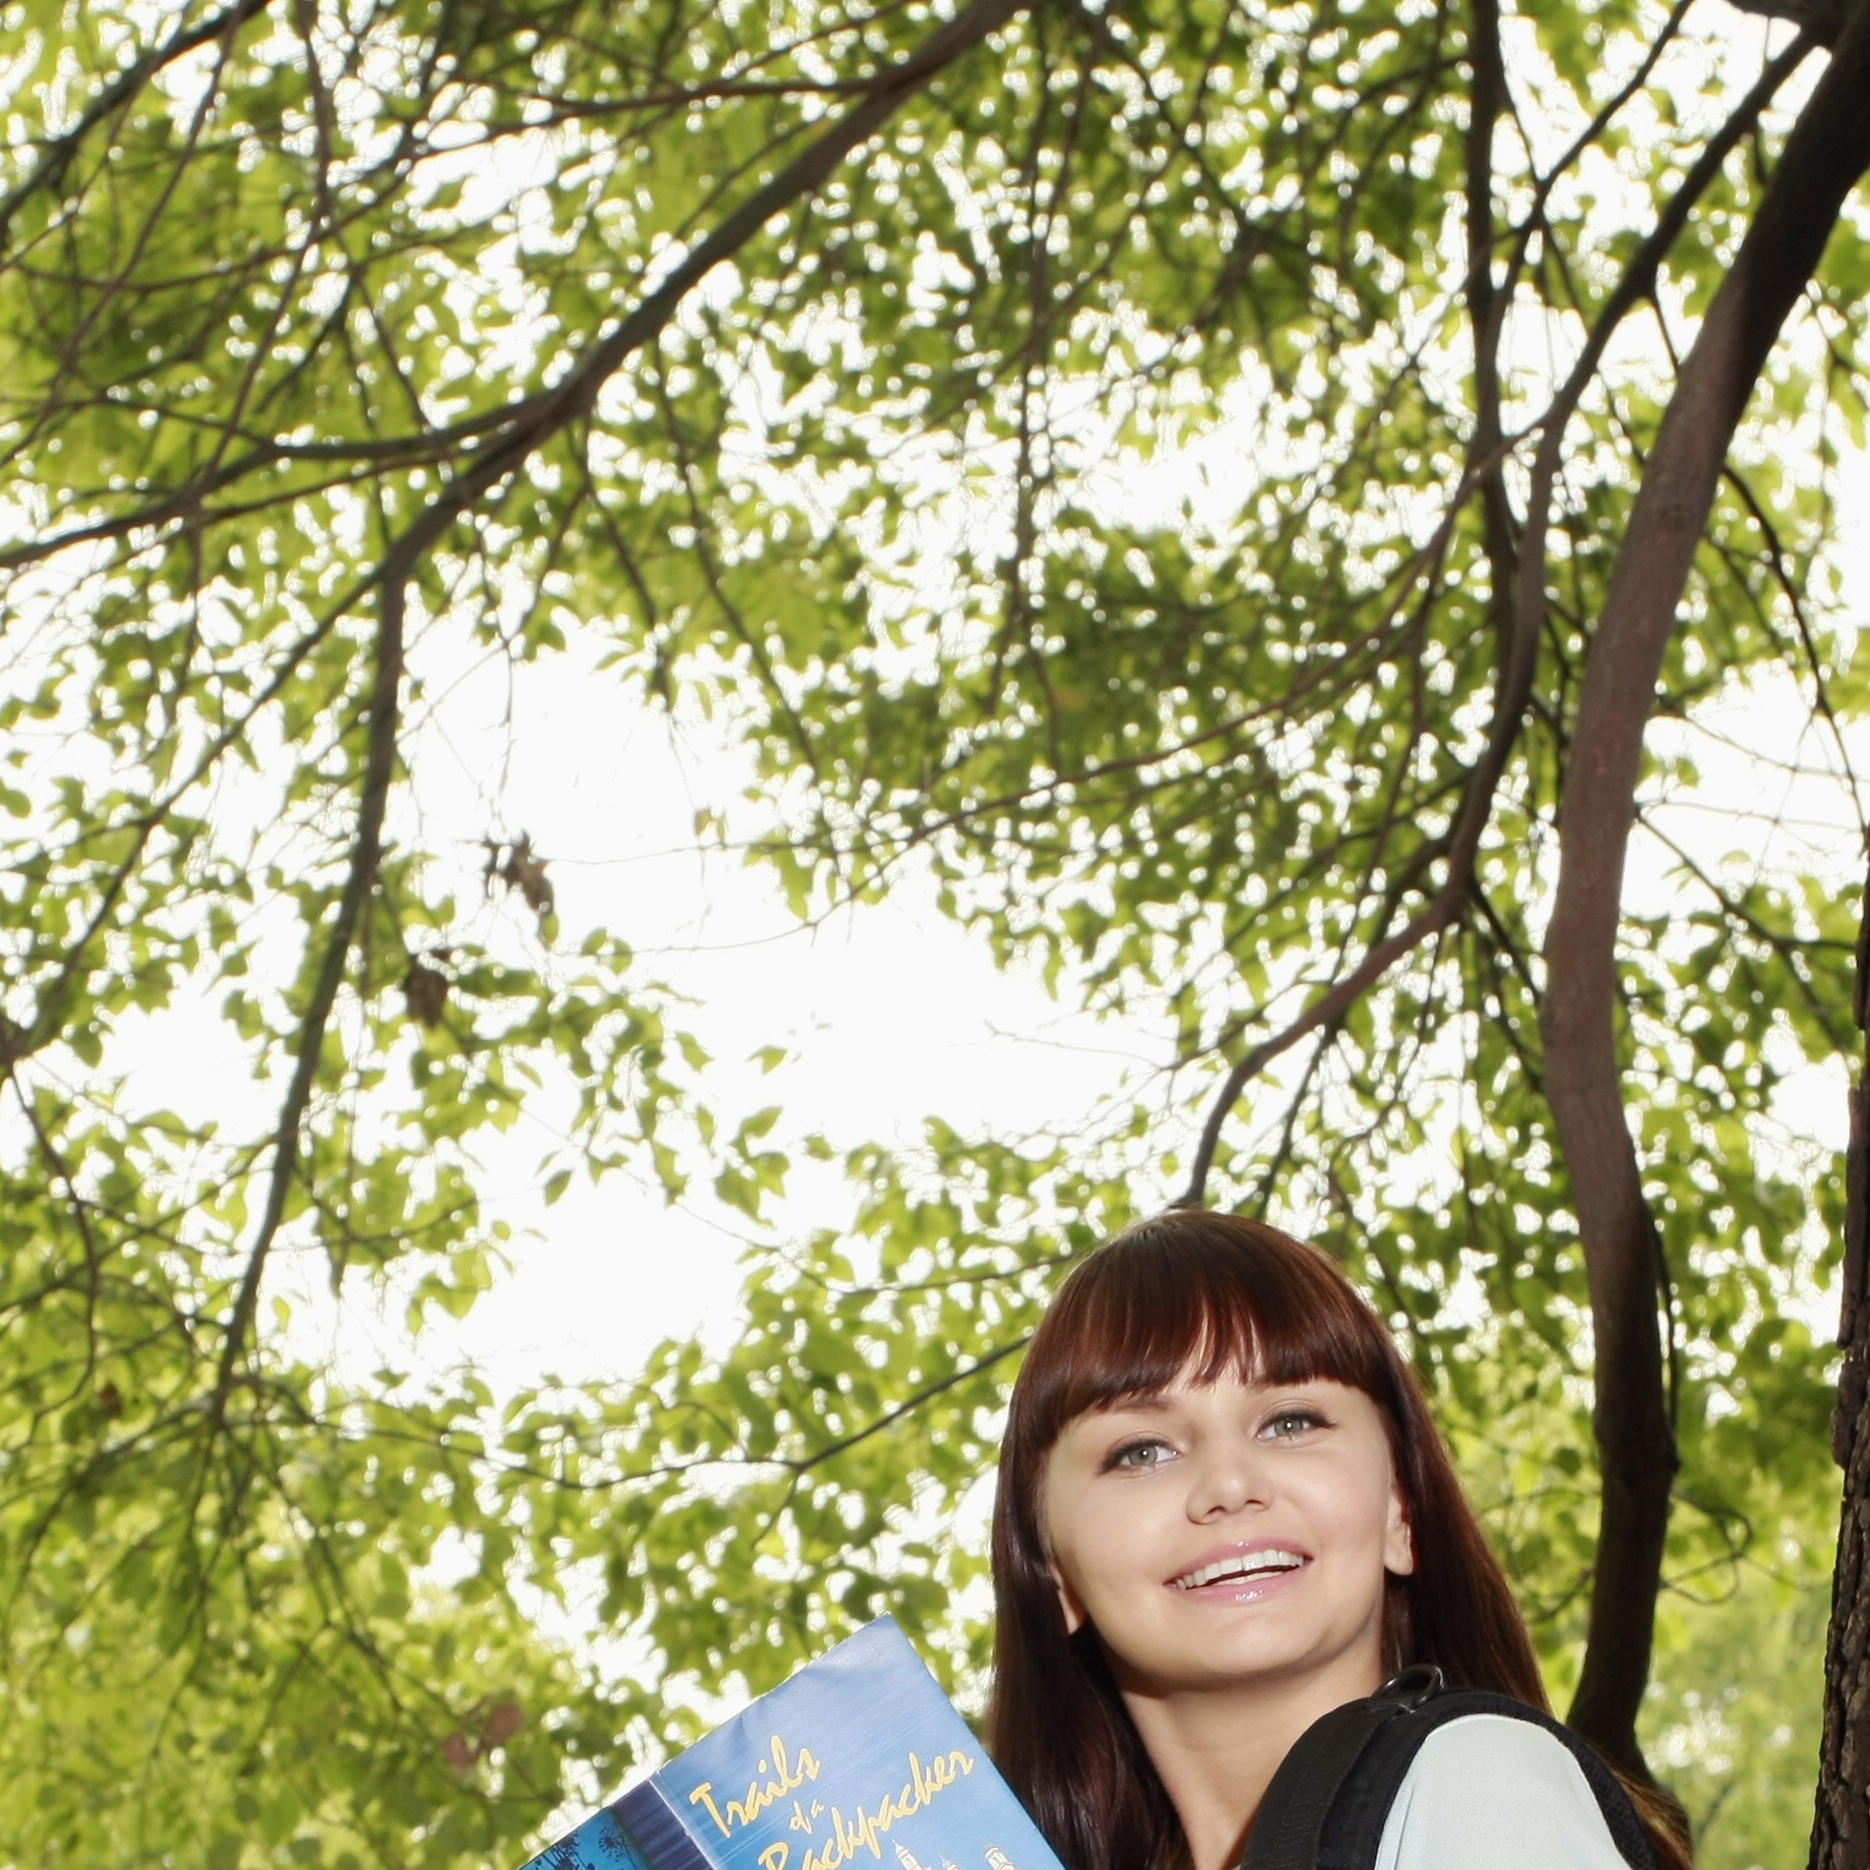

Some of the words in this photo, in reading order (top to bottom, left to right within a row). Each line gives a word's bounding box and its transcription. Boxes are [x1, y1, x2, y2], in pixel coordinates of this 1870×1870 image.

[689, 1735, 820, 1838] Trails
[789, 1801, 812, 1834] of
[811, 1799, 825, 1817] a
